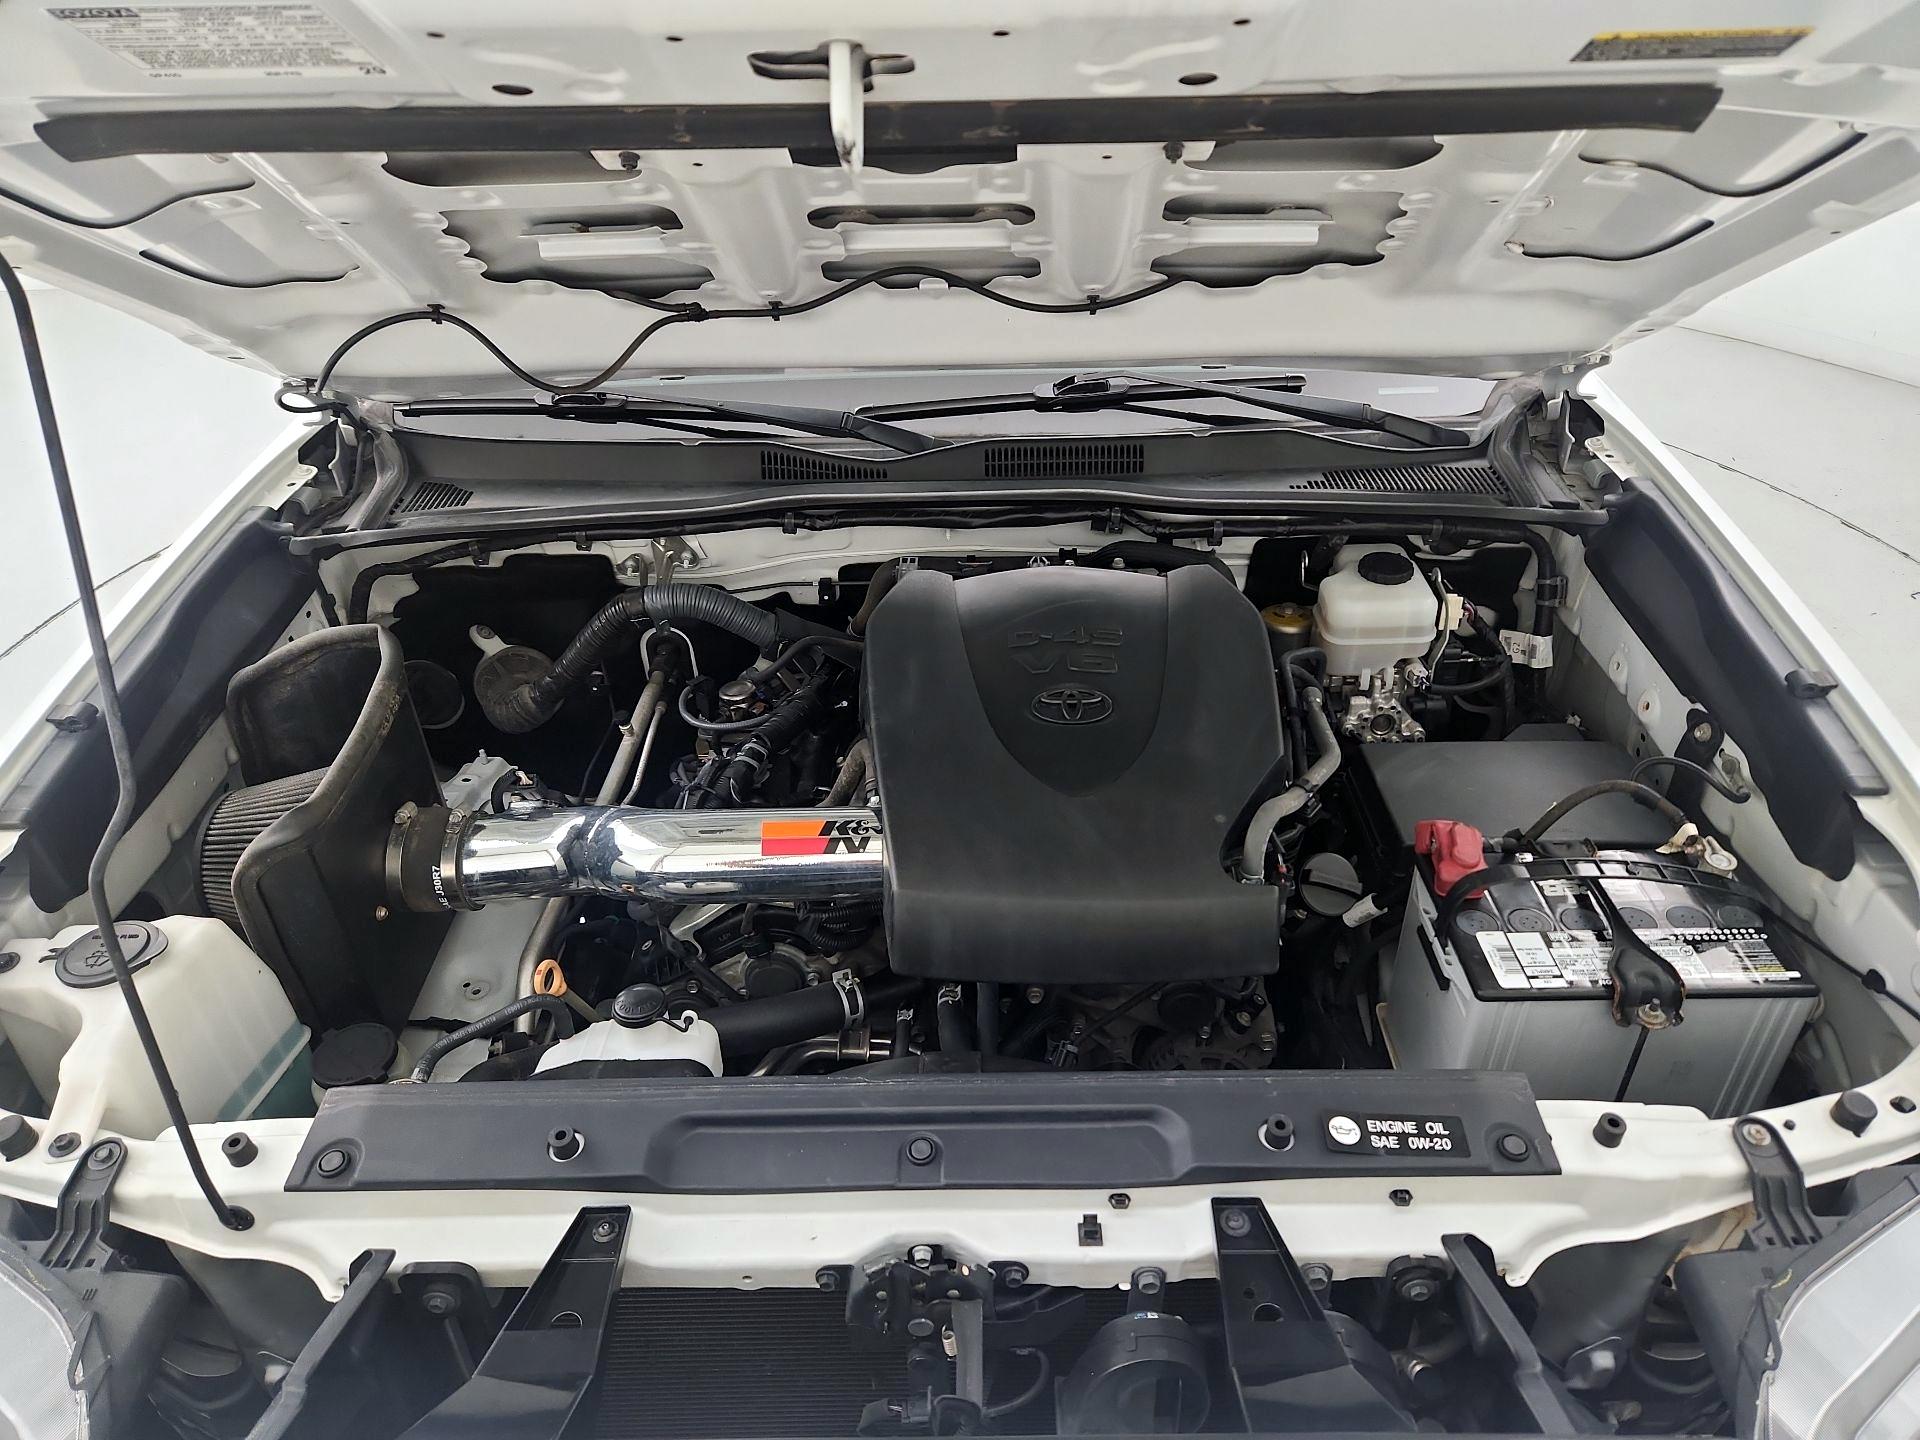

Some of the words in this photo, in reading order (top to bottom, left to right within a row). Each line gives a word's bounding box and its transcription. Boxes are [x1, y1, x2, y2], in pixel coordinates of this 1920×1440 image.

[54, 8, 138, 18] TOYOTA
[1009, 649, 1119, 673] V6
[432, 865, 445, 896] J30R7
[1366, 1120, 1418, 1134] ENGINE
[1425, 1122, 1450, 1135] OIL
[1370, 1135, 1400, 1149] SAE
[1407, 1137, 1452, 1151] 0W-20
